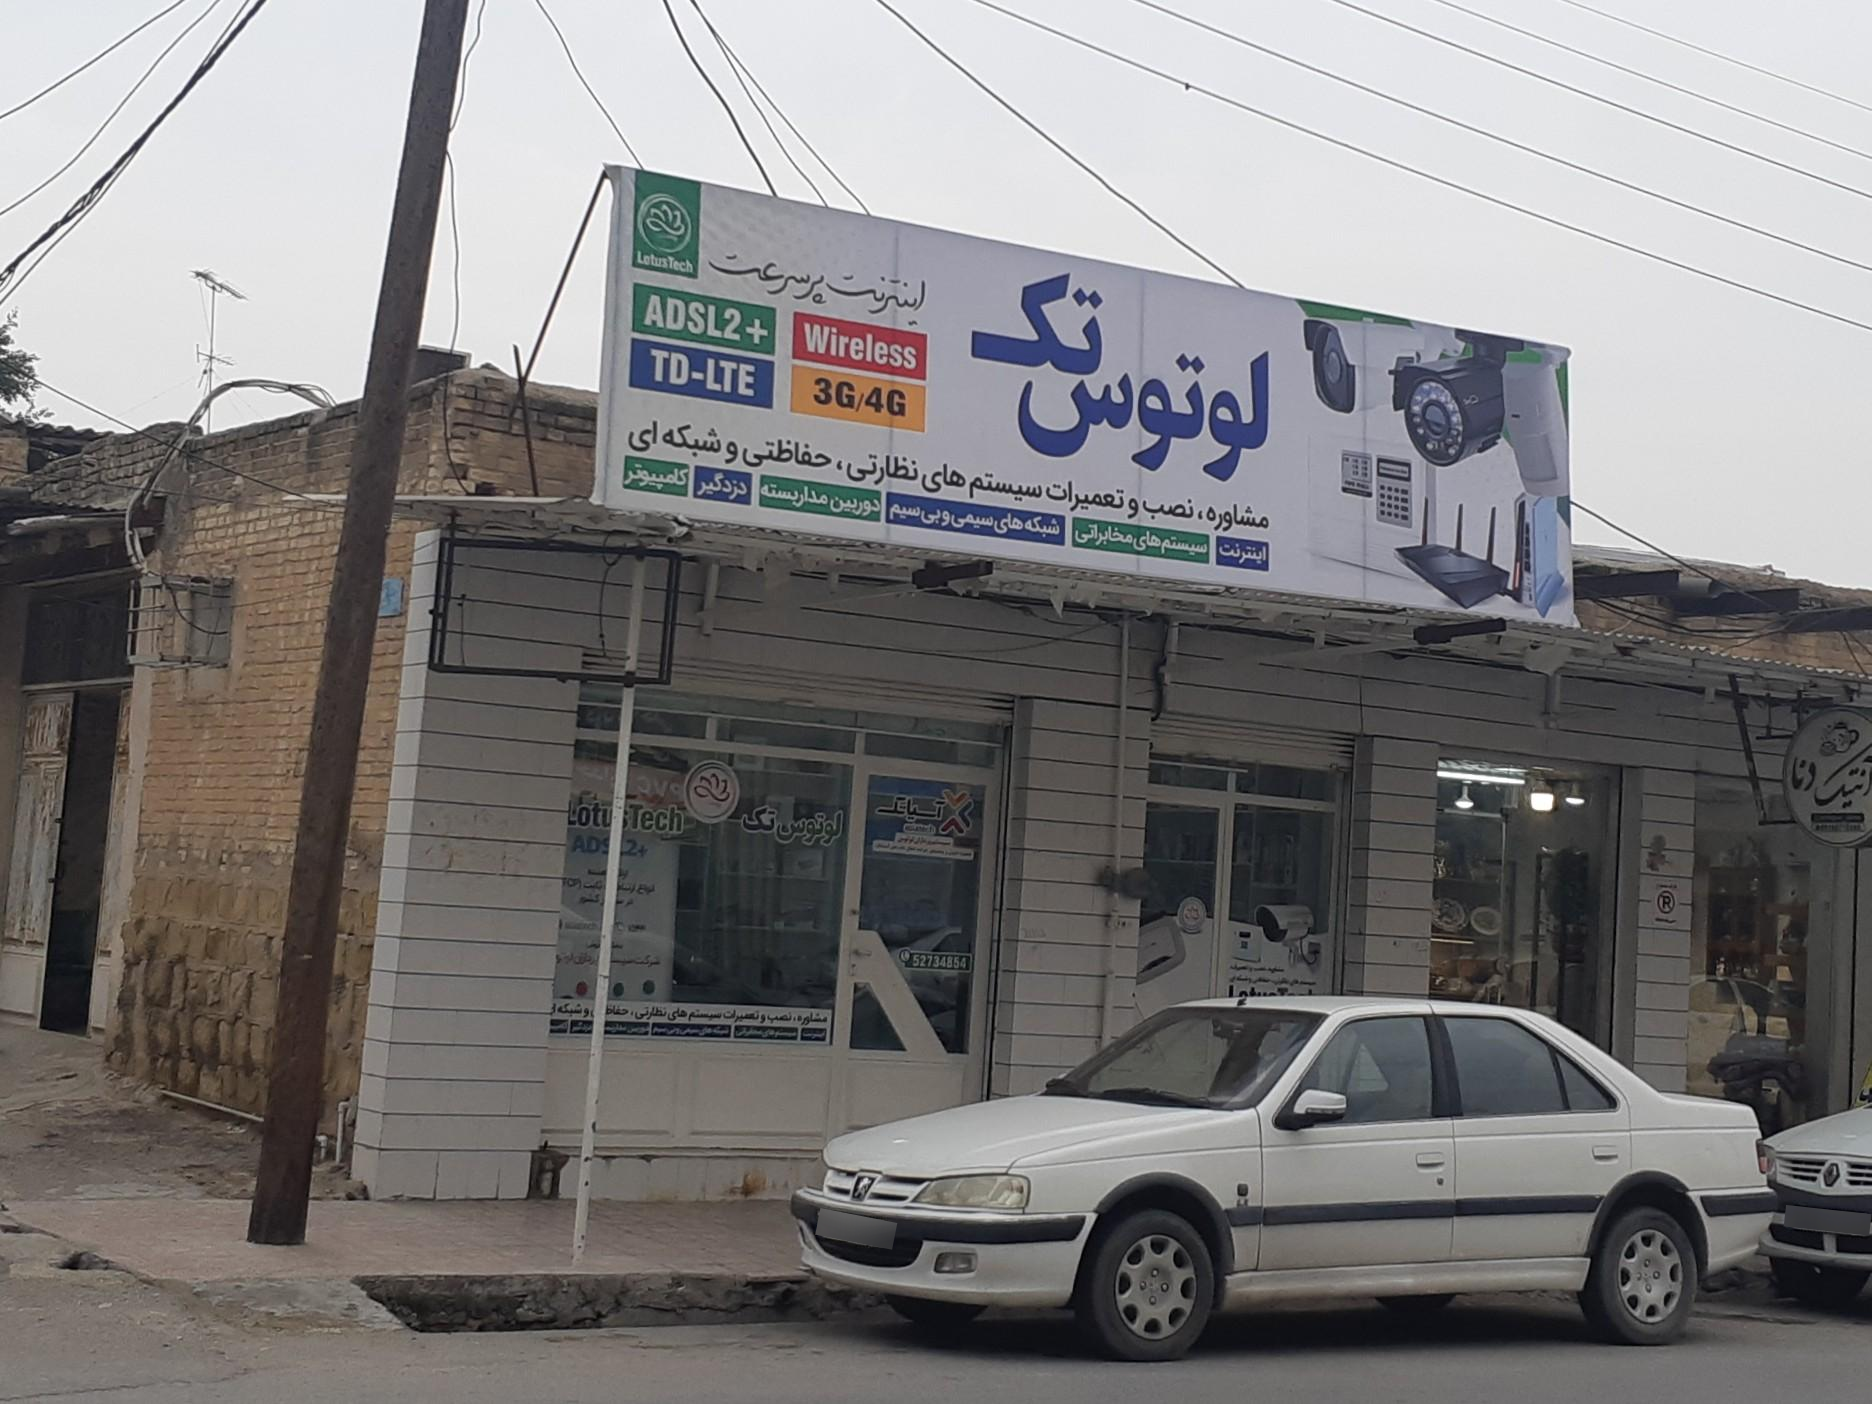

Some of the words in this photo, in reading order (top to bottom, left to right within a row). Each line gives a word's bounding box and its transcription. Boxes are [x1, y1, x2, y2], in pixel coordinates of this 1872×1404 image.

[637, 251, 693, 273] LotusTech
[827, 276, 926, 327] اینترنت
[644, 294, 769, 345] ADSL2+
[971, 272, 1103, 376] تک
[803, 322, 918, 370] Wireless
[650, 349, 756, 397] TD-LTE
[813, 377, 907, 417] 3G/4G
[1018, 350, 1269, 482] لوتوس
[628, 420, 658, 453] ای
[661, 424, 722, 459] شبکه
[725, 440, 739, 464] و
[742, 439, 832, 469] حفاظتی
[624, 463, 689, 489] کامپیوتر
[697, 472, 748, 500] دزدگیر
[921, 463, 966, 494] های
[969, 472, 1043, 502] سیستم
[760, 483, 829, 507] مداربسته
[829, 494, 881, 517] دوربین
[1046, 480, 1125, 512] تعمیرات
[1127, 497, 1140, 518] و
[1142, 498, 1194, 520] نصب
[889, 503, 921, 520] سیم
[951, 513, 994, 530] سیمی
[1075, 523, 1134, 549] مخابراتی
[1218, 539, 1267, 565] اینترنت
[568, 800, 683, 833] LotuTech
[742, 805, 777, 834] تک
[876, 796, 946, 820] آسیاتک
[776, 810, 843, 846] لوتوس
[571, 835, 648, 857] ADS2+
[767, 1011, 792, 1023] نصب
